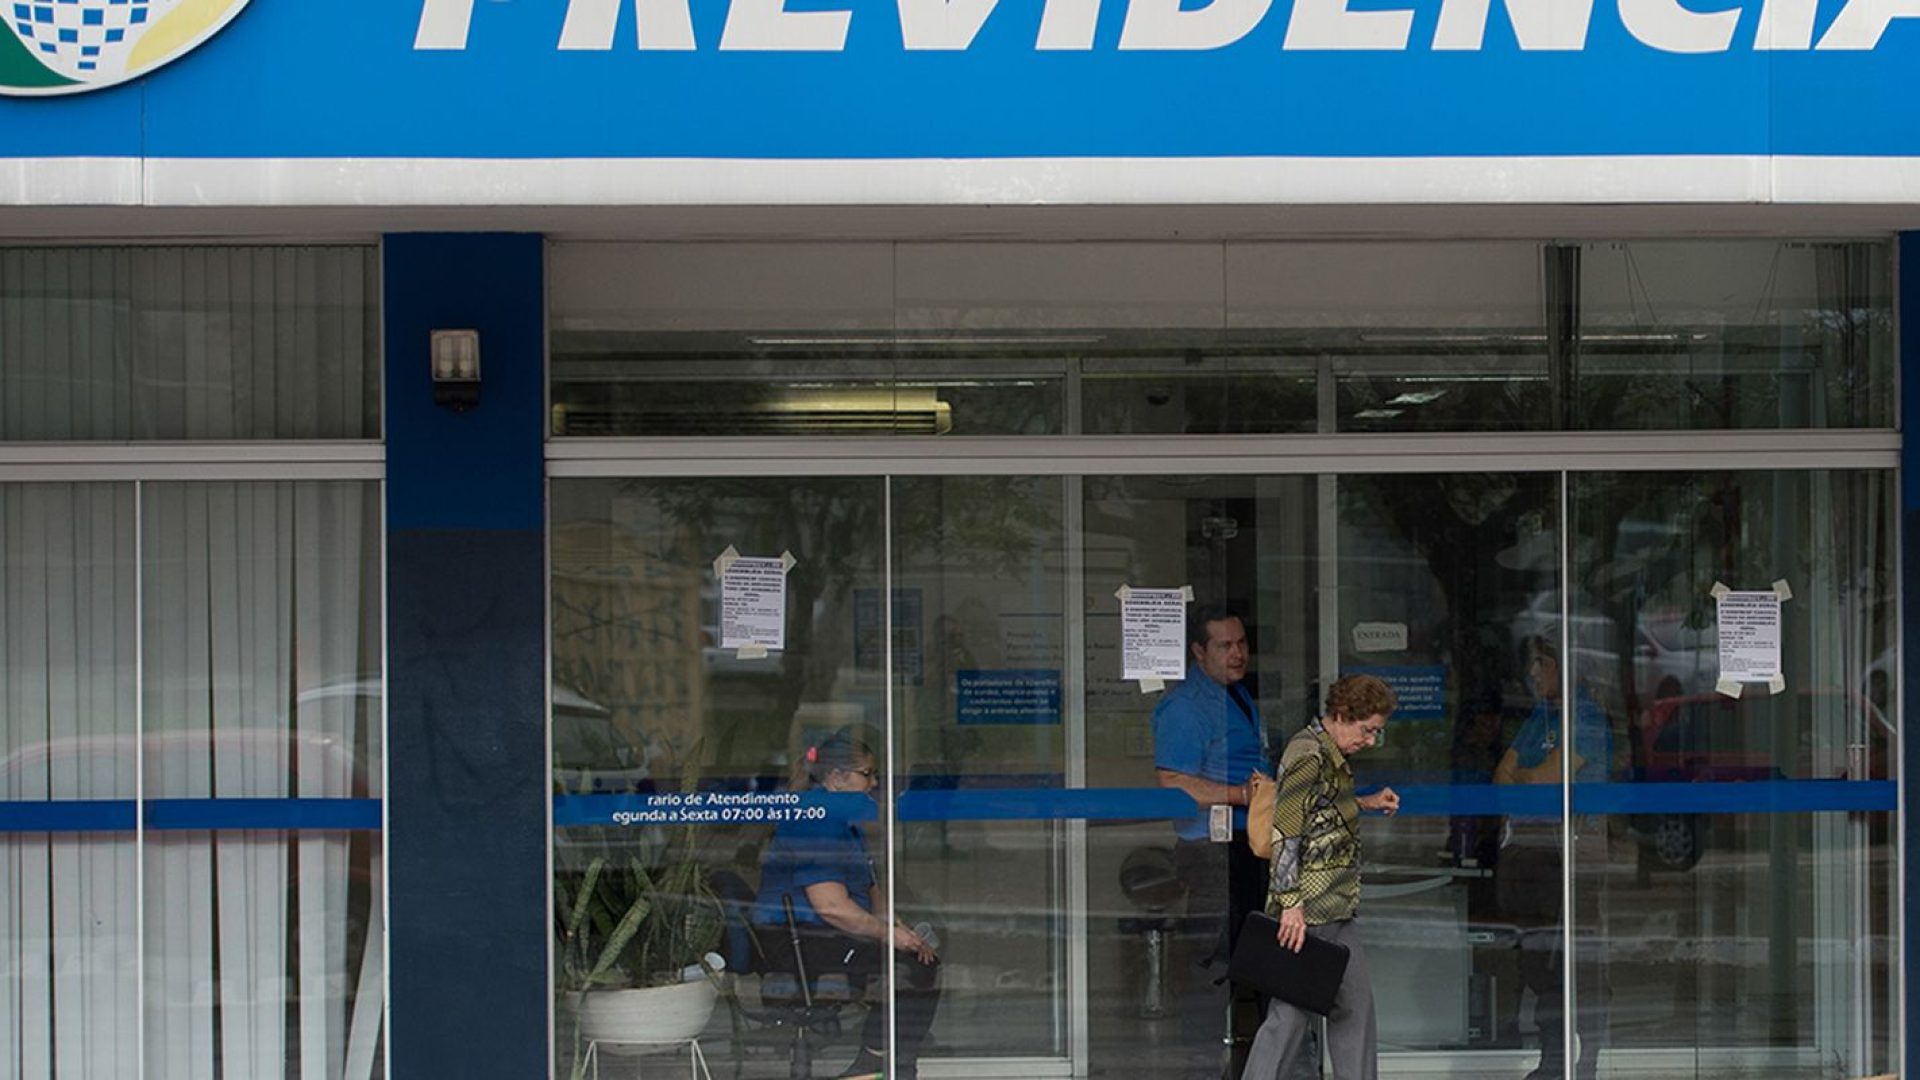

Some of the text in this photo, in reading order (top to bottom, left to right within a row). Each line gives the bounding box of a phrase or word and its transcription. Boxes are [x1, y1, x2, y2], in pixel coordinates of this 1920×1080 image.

[1357, 631, 1401, 639] ENTRADA
[684, 792, 702, 806] de
[706, 792, 800, 806] Atendimento
[668, 811, 679, 822] a
[679, 806, 719, 822] Sexta
[721, 807, 764, 821] 07:00
